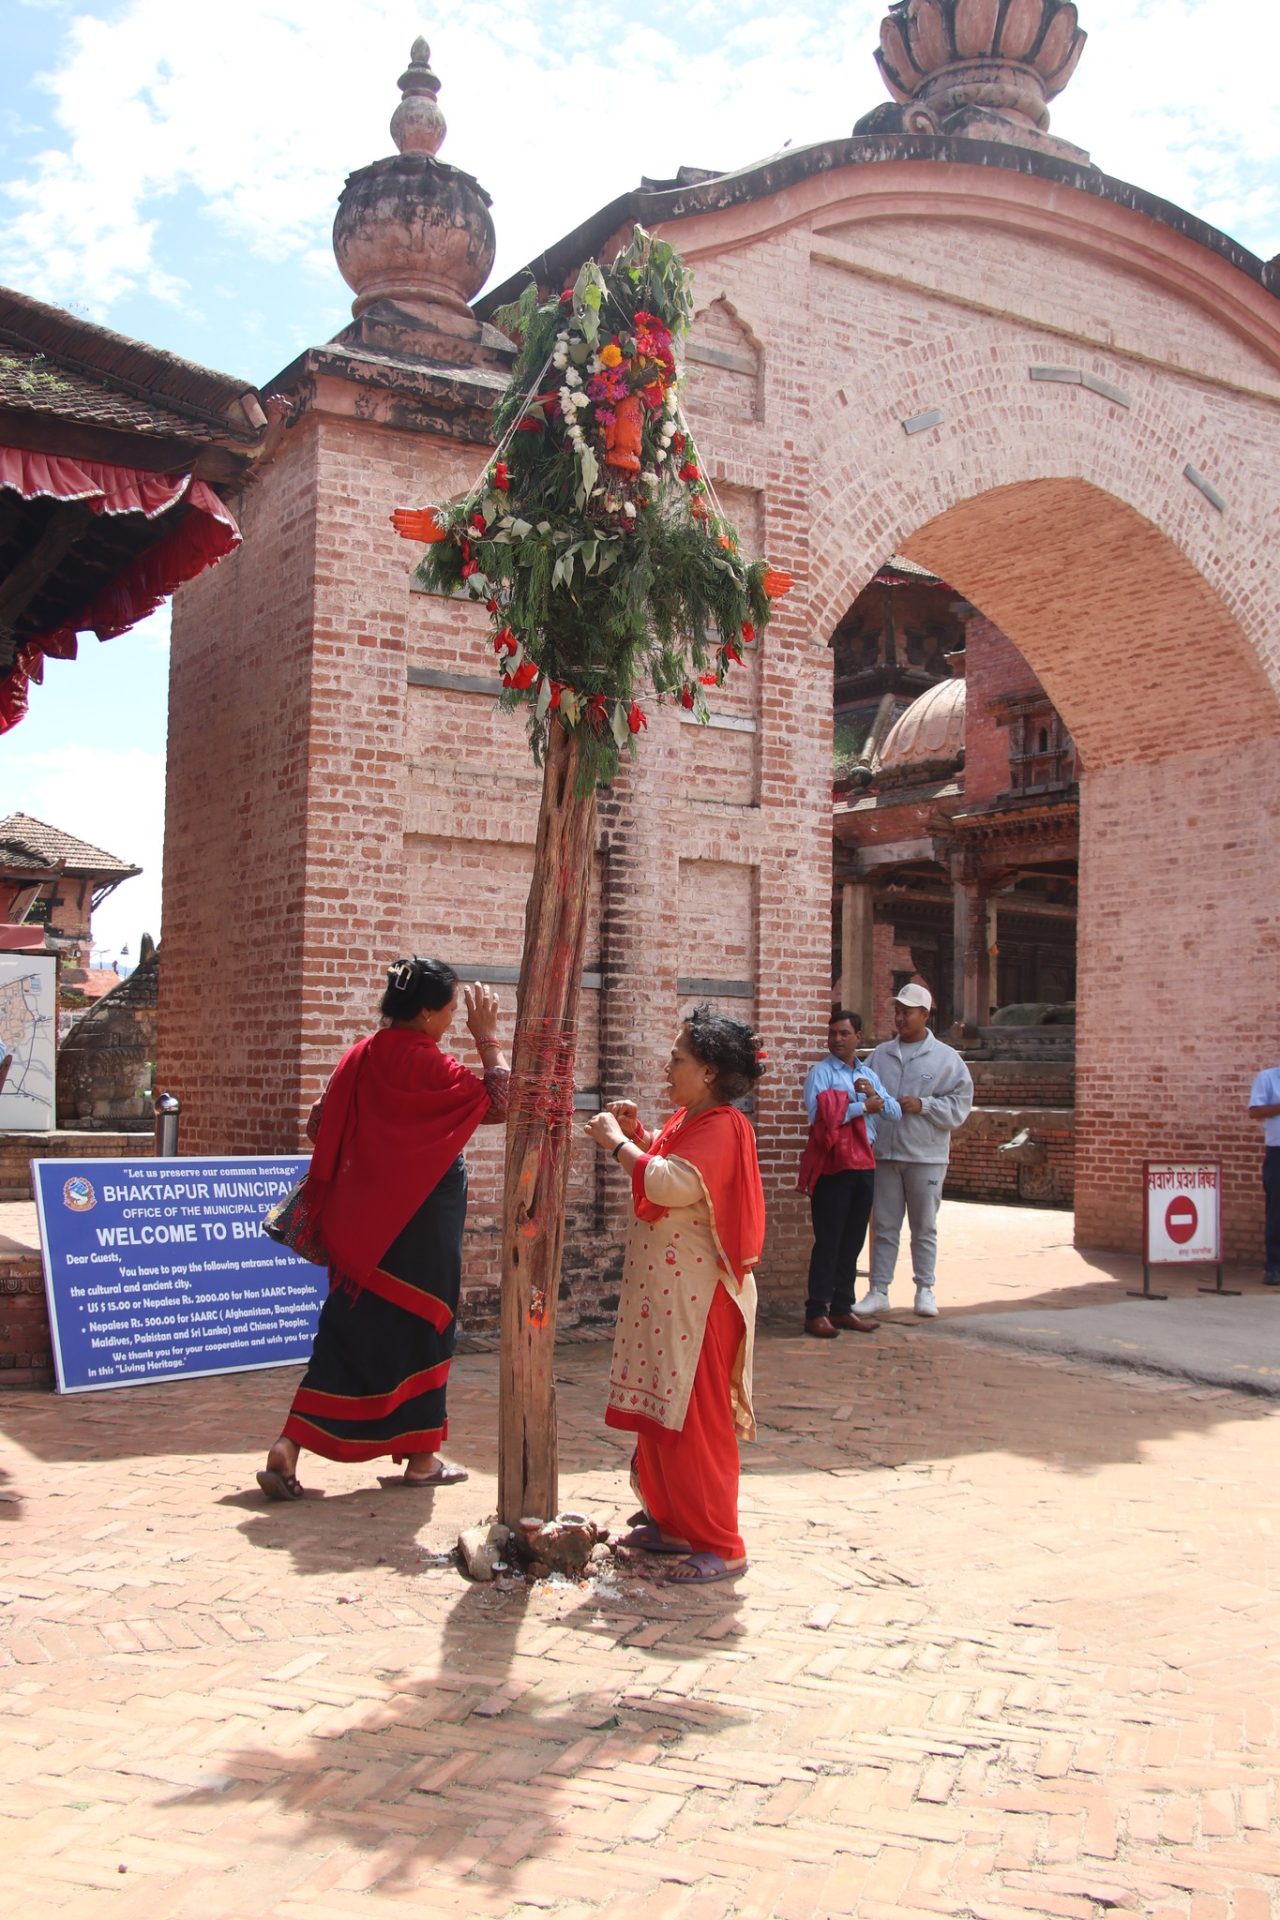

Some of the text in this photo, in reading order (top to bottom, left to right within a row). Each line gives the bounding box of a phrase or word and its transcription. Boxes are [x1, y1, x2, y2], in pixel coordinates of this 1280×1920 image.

[123, 1169, 144, 1178] "Let
[146, 1170, 158, 1178] us
[160, 1169, 200, 1179] preserve
[220, 1168, 257, 1176] common
[258, 1165, 299, 1176] heritage"
[103, 1183, 210, 1202] BHAKTAPUR
[122, 1207, 162, 1219] OFFICE
[164, 1207, 178, 1217] OF
[180, 1205, 201, 1216] THE
[203, 1204, 256, 1215] MUNICIPAL
[95, 1221, 270, 1247] WELCOME TO BHA
[66, 1252, 122, 1265] Dear Guests,
[119, 1266, 137, 1277] You
[138, 1265, 159, 1276] have
[161, 1265, 170, 1274] to
[171, 1265, 187, 1276] pay
[188, 1262, 203, 1272] the
[203, 1260, 240, 1271] following
[241, 1259, 274, 1269] entrance
[275, 1256, 287, 1266] fee
[288, 1256, 296, 1265] to
[70, 1278, 192, 1297] the cultural and ancient city.
[87, 1284, 318, 1313] US $ 15.00 or Nepalese Rs. 2000.00 for Non SAARC Peoples.
[89, 1319, 129, 1333] Nepalese
[130, 1318, 143, 1328] Rs.
[145, 1315, 176, 1327] 500.00
[177, 1313, 189, 1323] for
[190, 1310, 218, 1322] SAARC
[225, 1306, 274, 1320] Afghanistan,
[274, 1302, 319, 1314] Bangladesh,
[91, 1317, 309, 1348] Maldives, Pakistan and Sri Lanka) and Chinese Peoples.
[112, 1352, 127, 1362] We
[128, 1349, 154, 1360] thank
[155, 1349, 170, 1359] you
[171, 1346, 184, 1356] for
[185, 1344, 203, 1355] your
[204, 1338, 250, 1352] cooperation
[250, 1336, 265, 1346] and
[266, 1334, 283, 1344] wish
[284, 1335, 298, 1344] you
[298, 1332, 309, 1341] for
[98, 1366, 114, 1376] this
